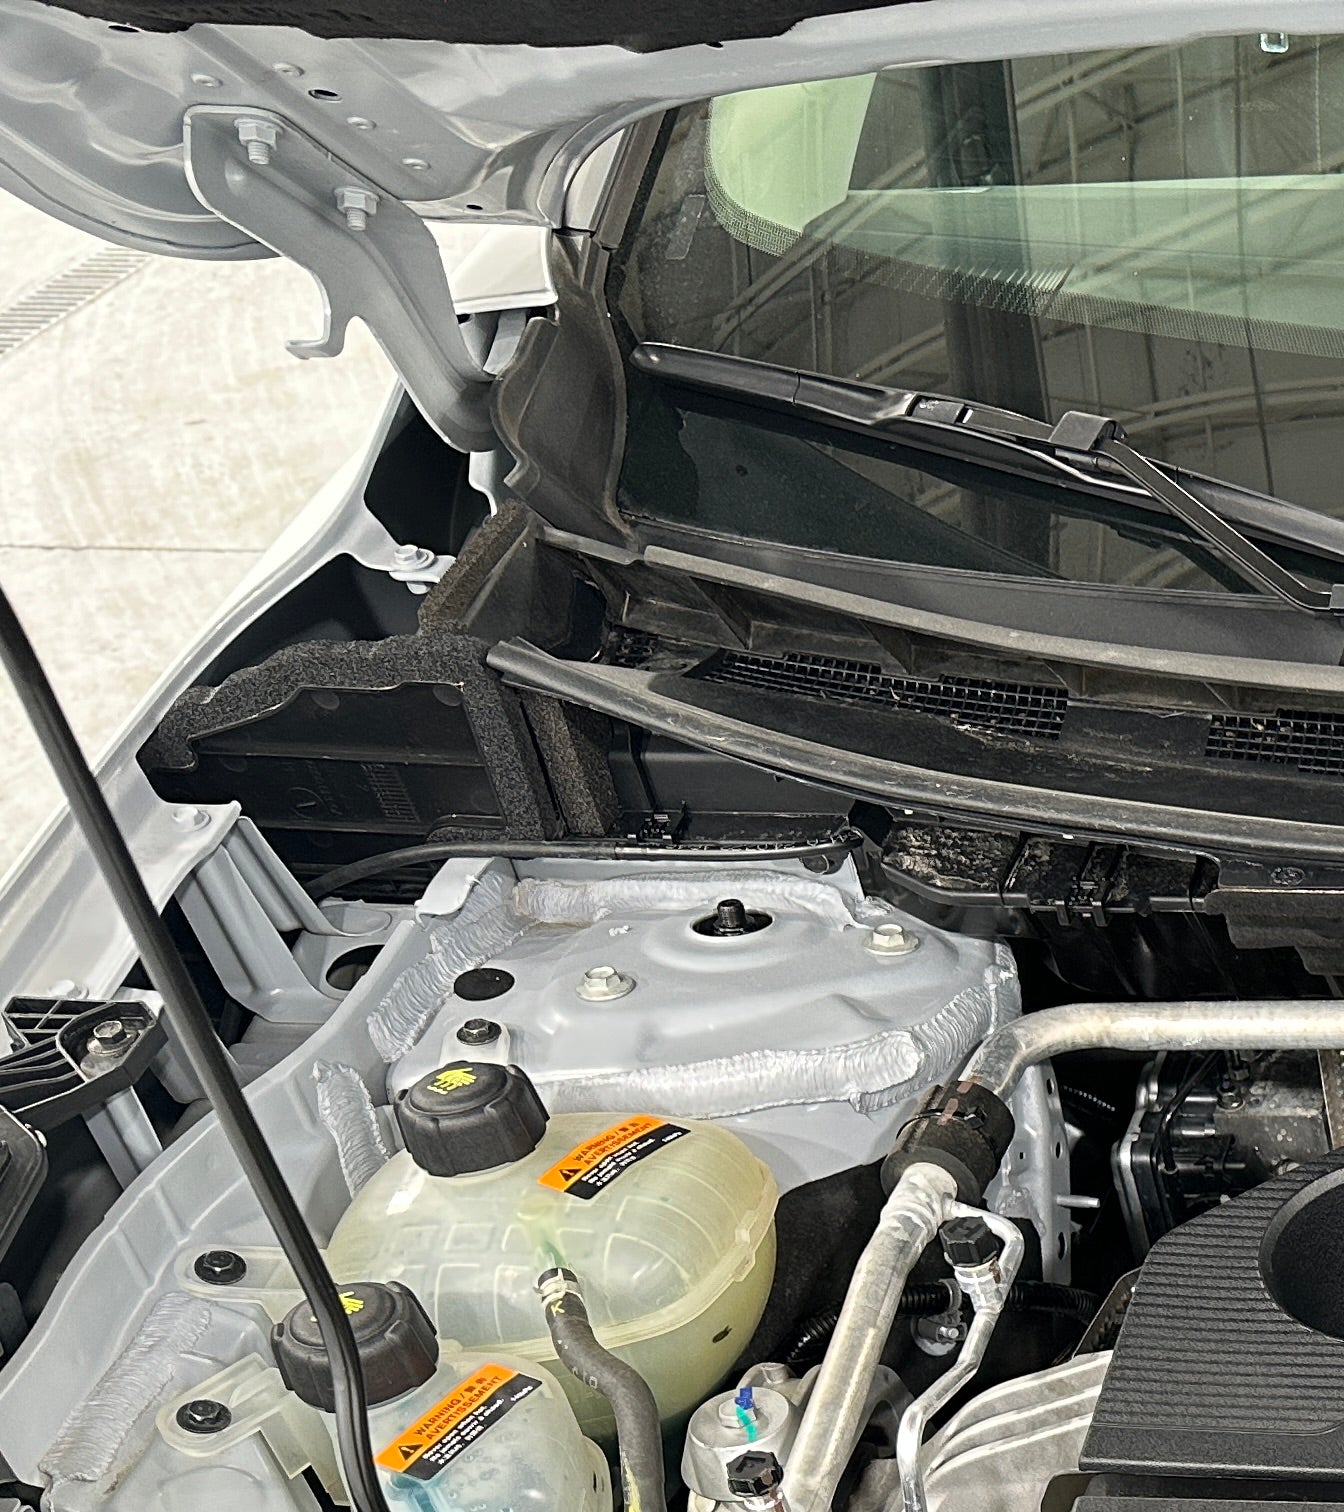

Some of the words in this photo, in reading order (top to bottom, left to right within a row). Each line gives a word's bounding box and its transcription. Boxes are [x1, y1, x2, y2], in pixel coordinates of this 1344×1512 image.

[574, 1133, 615, 1161] WARNING
[584, 1122, 652, 1166] AVERTISSEMENT
[551, 1300, 565, 1317] K
[414, 1398, 461, 1436] WARNING
[426, 1375, 502, 1440] AVERTISSEMENT
